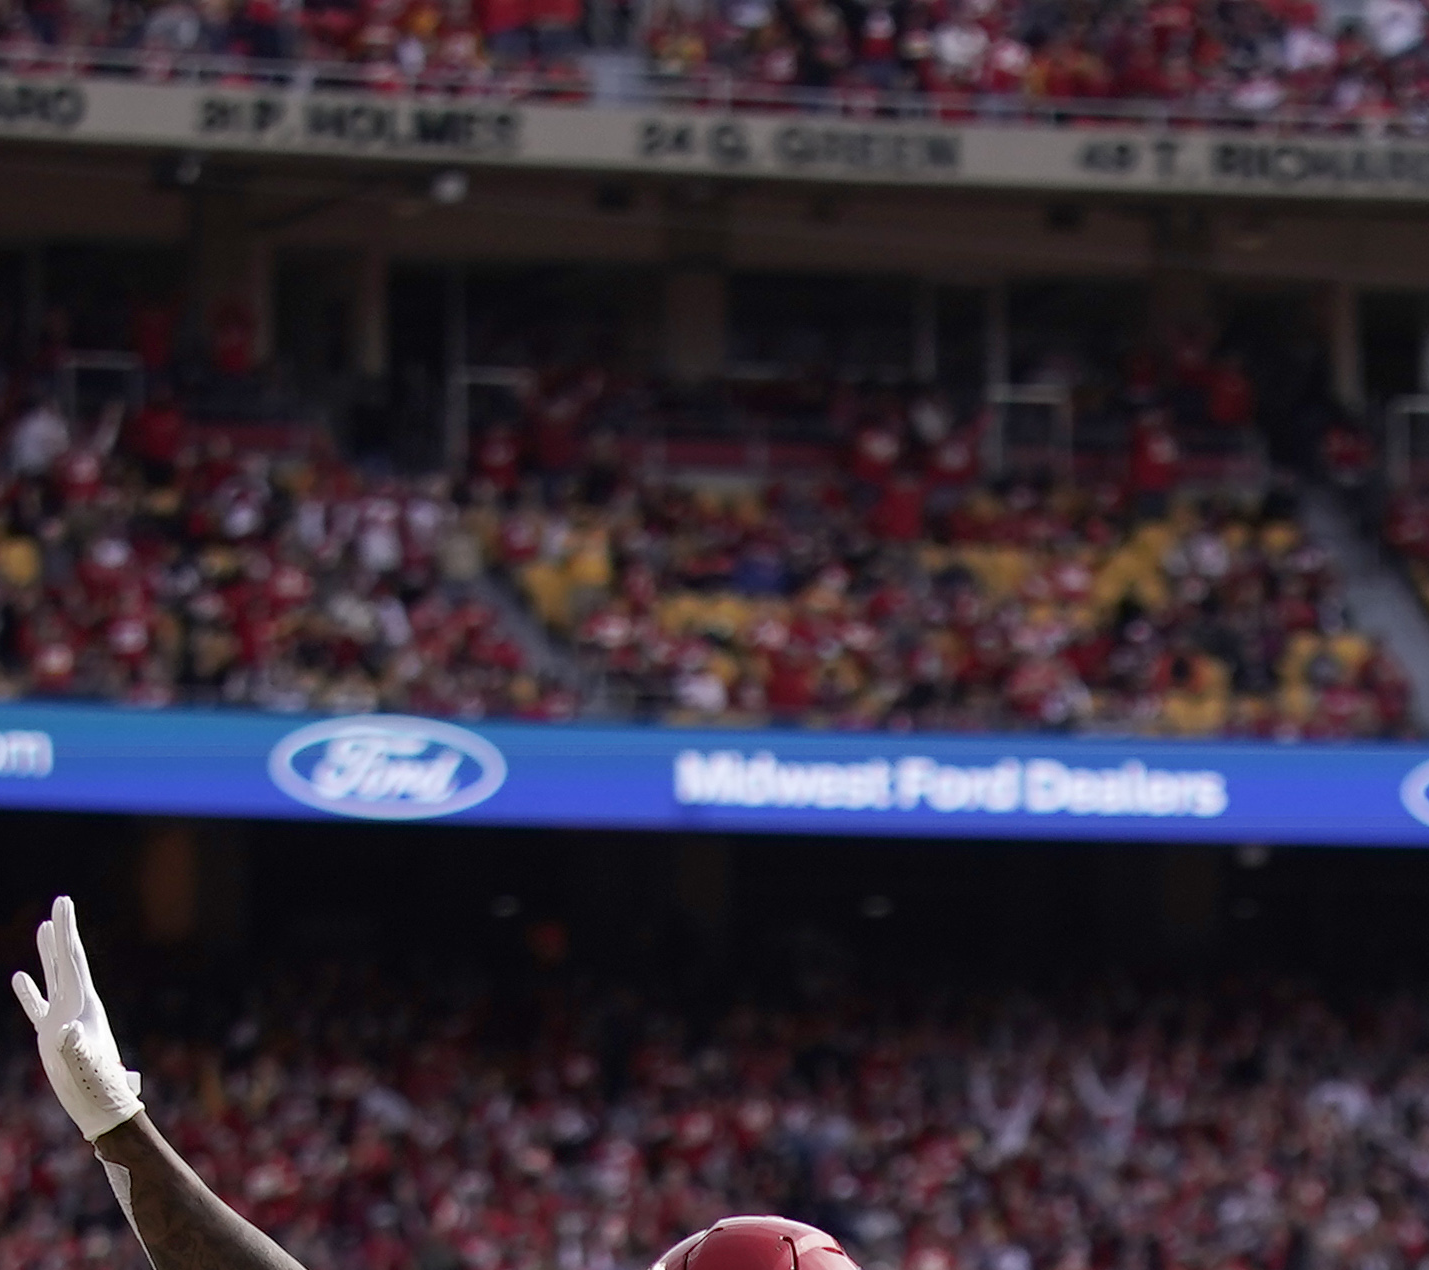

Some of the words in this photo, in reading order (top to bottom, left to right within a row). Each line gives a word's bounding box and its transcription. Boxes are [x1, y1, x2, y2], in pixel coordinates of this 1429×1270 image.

[303, 101, 523, 148] HOLMES
[773, 126, 963, 170] GREEN
[311, 729, 462, 804] Ford
[674, 749, 890, 811] Midwest
[891, 754, 1024, 815] Ford
[1025, 757, 1229, 818] Dealers
